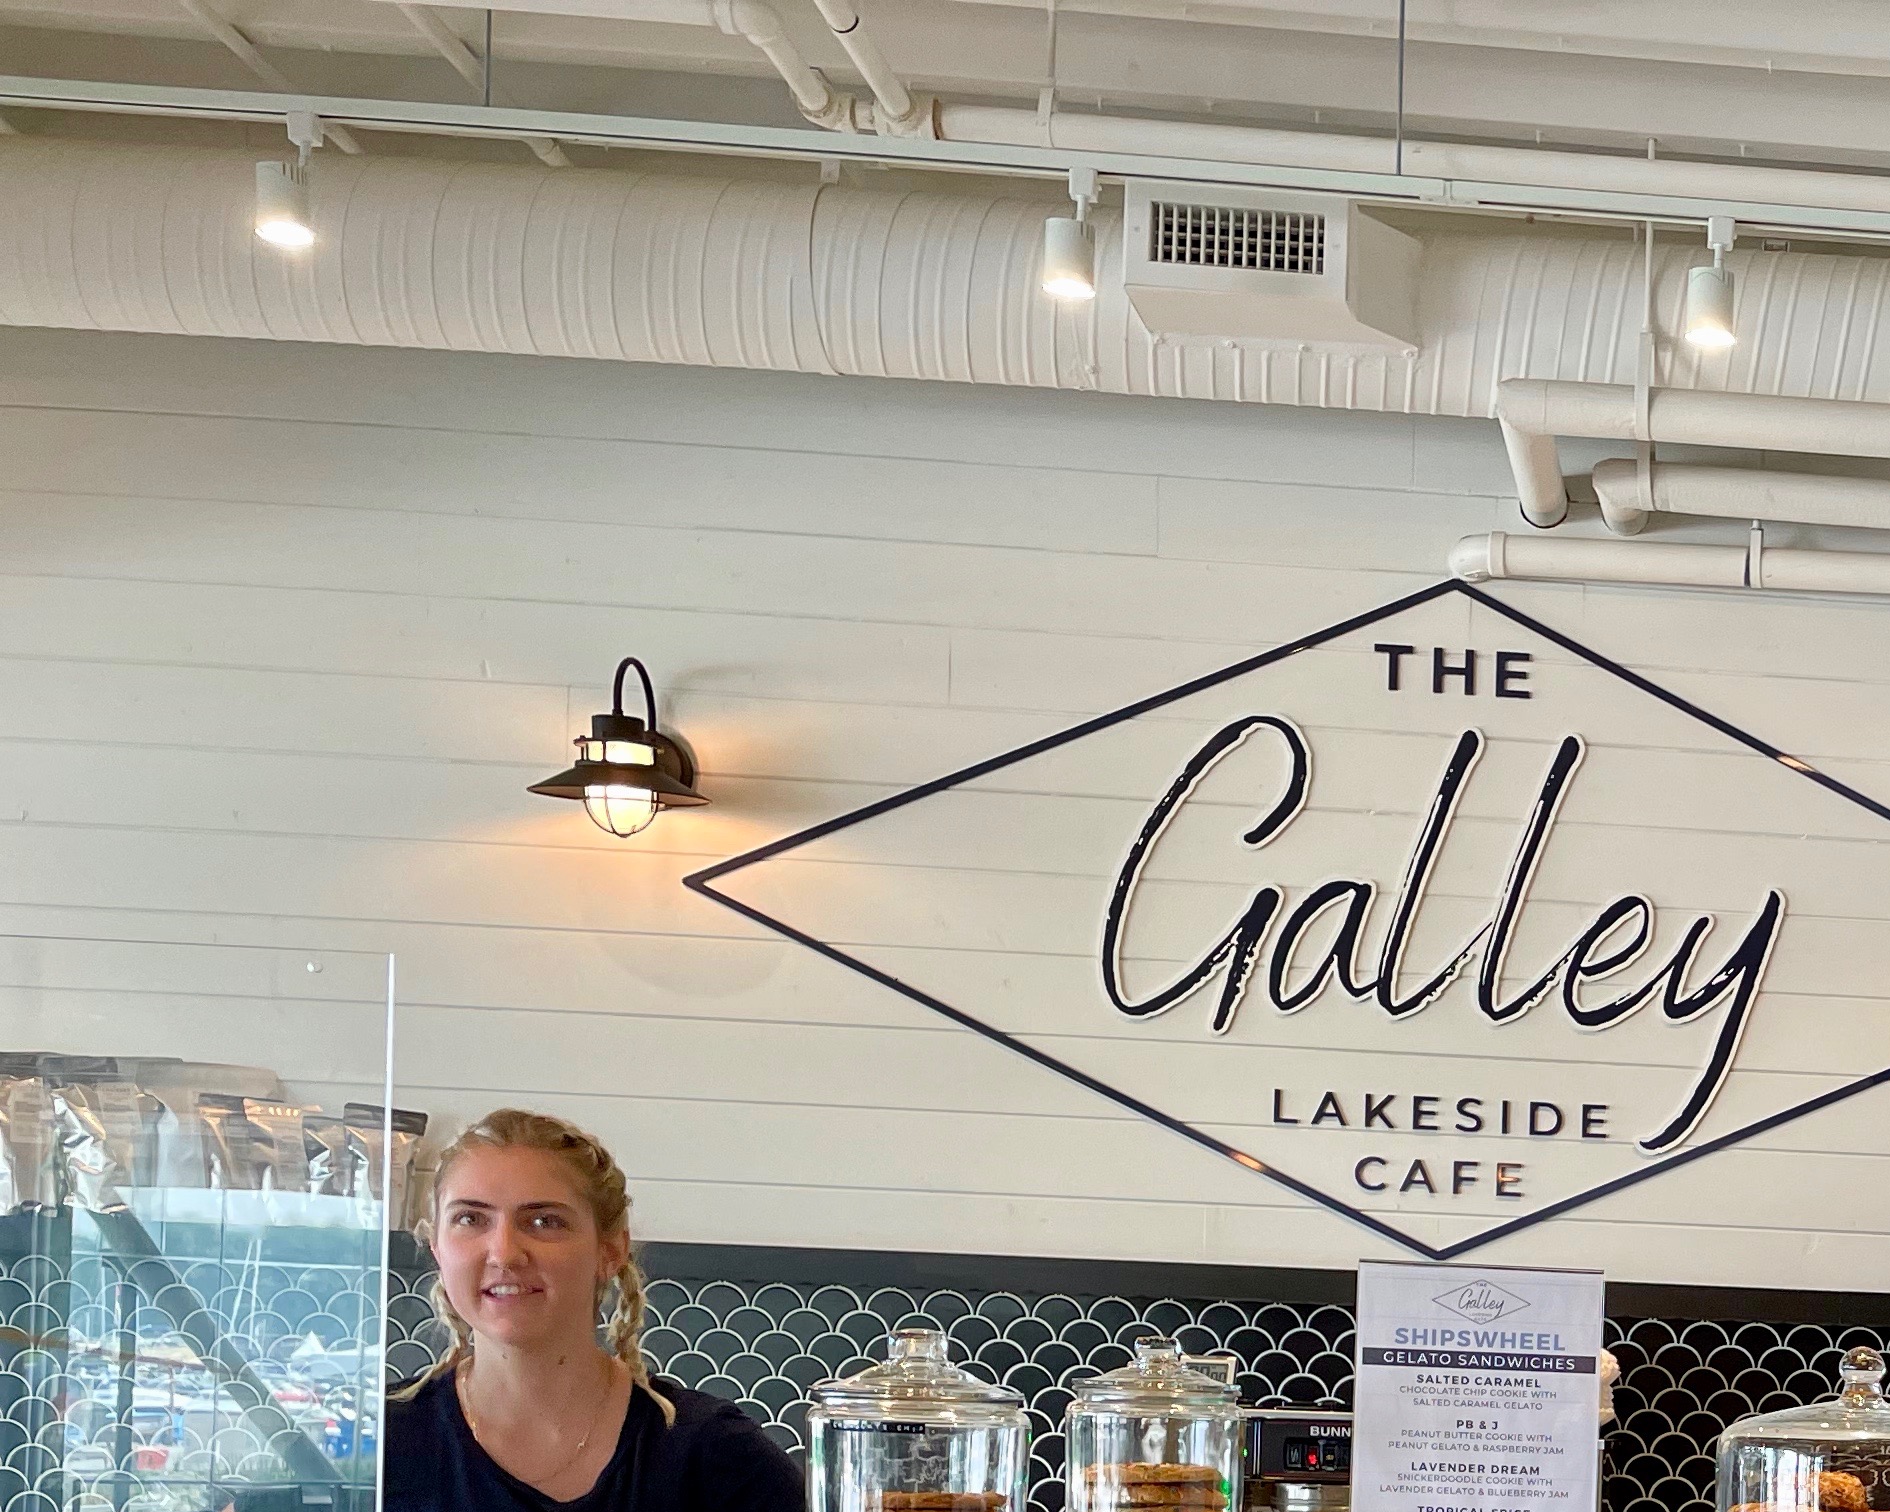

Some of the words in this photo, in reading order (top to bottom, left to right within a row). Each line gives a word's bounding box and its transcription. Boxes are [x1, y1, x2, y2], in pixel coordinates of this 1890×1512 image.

[1374, 643, 1533, 700] THE
[1100, 714, 1786, 1155] Galley
[1272, 1088, 1611, 1139] LAKESIDE
[1354, 1156, 1525, 1198] CAFE
[1458, 1288, 1505, 1318] Galley
[1394, 1327, 1566, 1351] SHIPSWHEEL
[1383, 1351, 1451, 1366] GELATO
[1457, 1354, 1576, 1370] SANDWICHES
[1416, 1374, 1470, 1386] SALTED
[1474, 1377, 1542, 1388] CARAMEL
[1399, 1385, 1461, 1396] CHOCOLATE
[1463, 1387, 1487, 1396] CHIP
[1489, 1389, 1530, 1398] COOKIE
[1531, 1390, 1557, 1399] WITH
[1310, 1426, 1351, 1437] BUNN
[1456, 1420, 1474, 1430] PB
[1479, 1420, 1487, 1430] &
[1491, 1420, 1499, 1430] J
[1411, 1461, 1486, 1474] LAVENDER
[1490, 1464, 1541, 1476] DREAM
